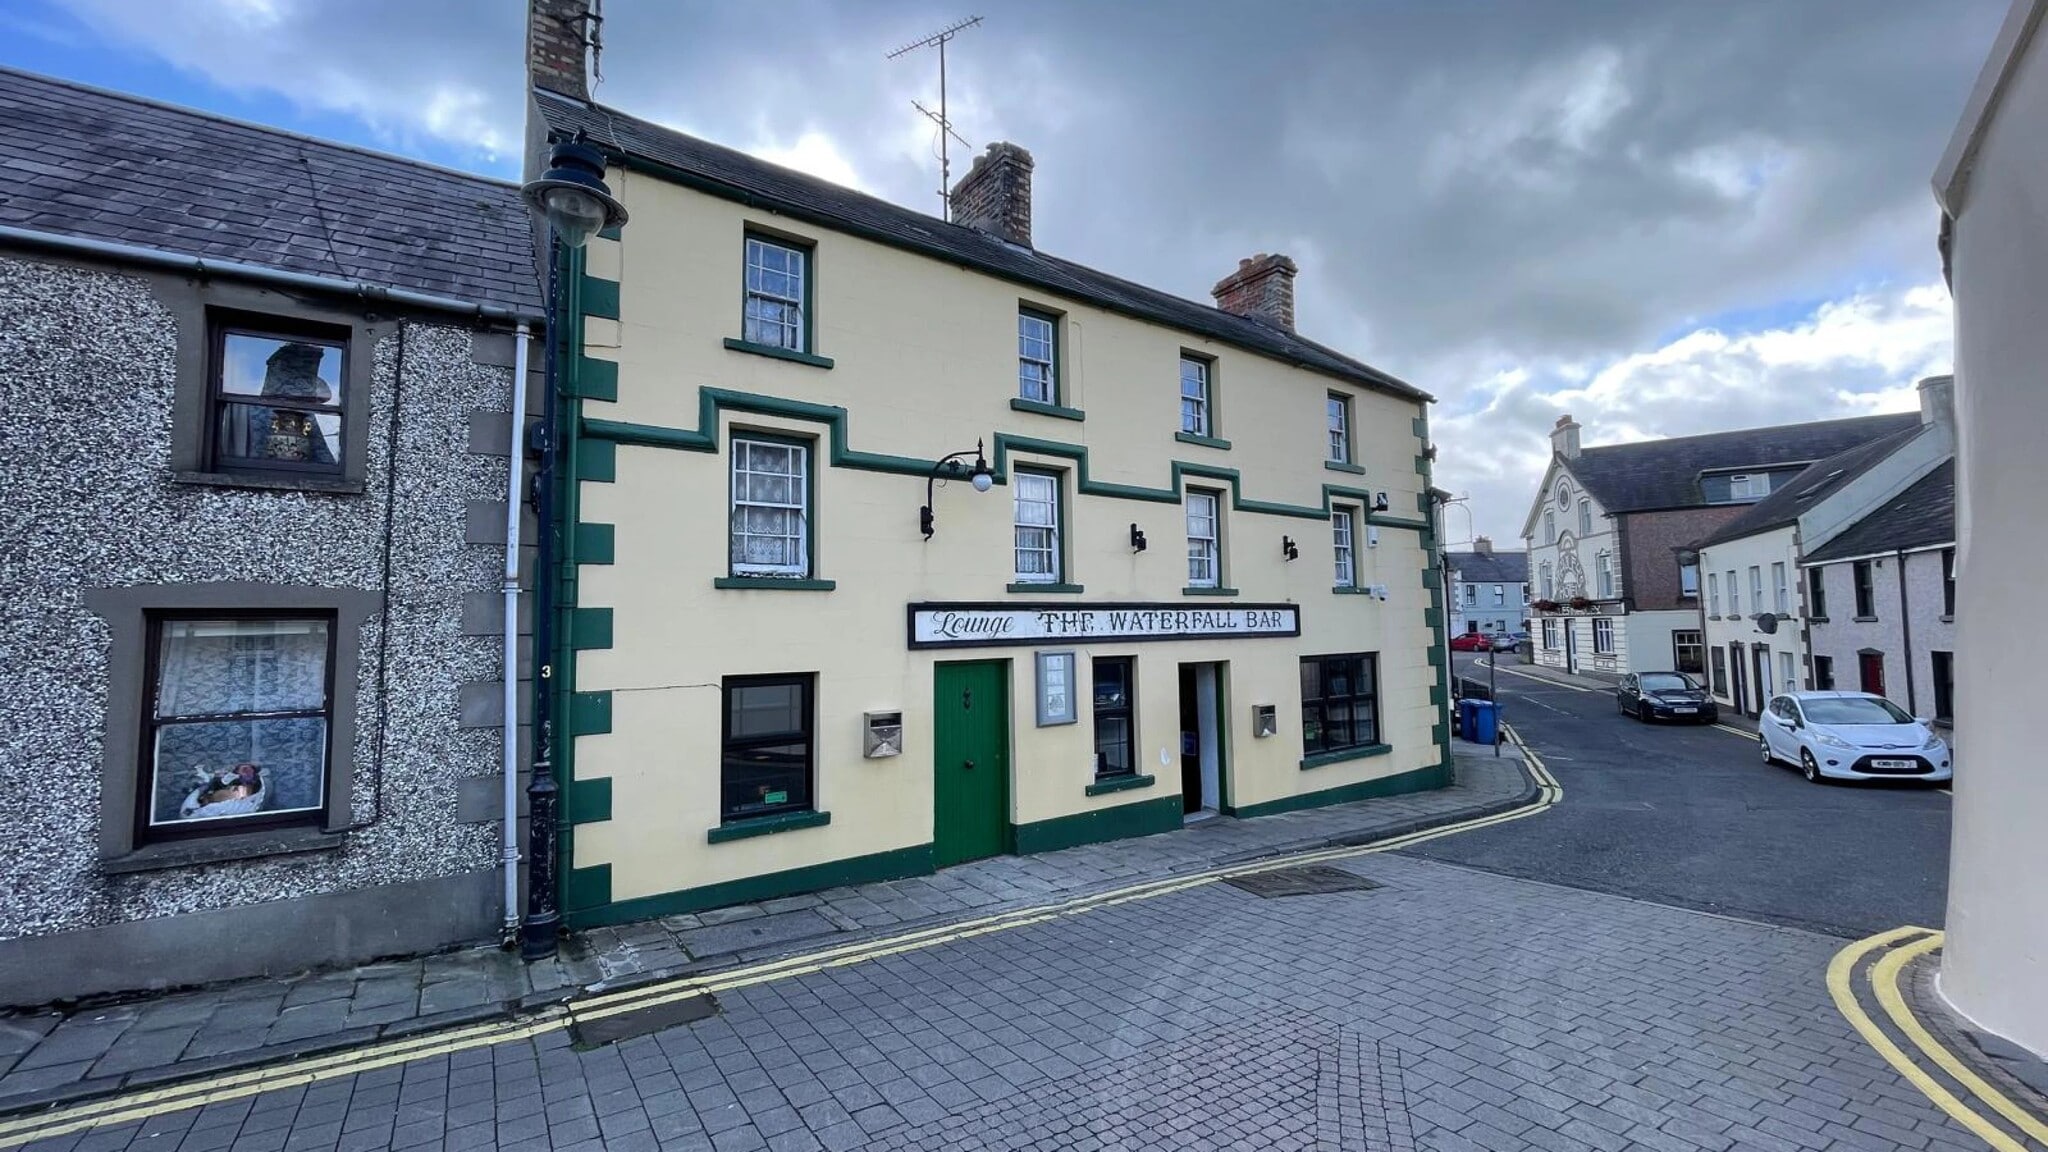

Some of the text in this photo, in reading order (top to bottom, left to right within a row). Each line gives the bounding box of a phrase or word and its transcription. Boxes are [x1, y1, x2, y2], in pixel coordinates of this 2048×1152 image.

[933, 611, 1283, 639] Lounge THE WATERFALL BAR
[541, 665, 551, 678] 3
